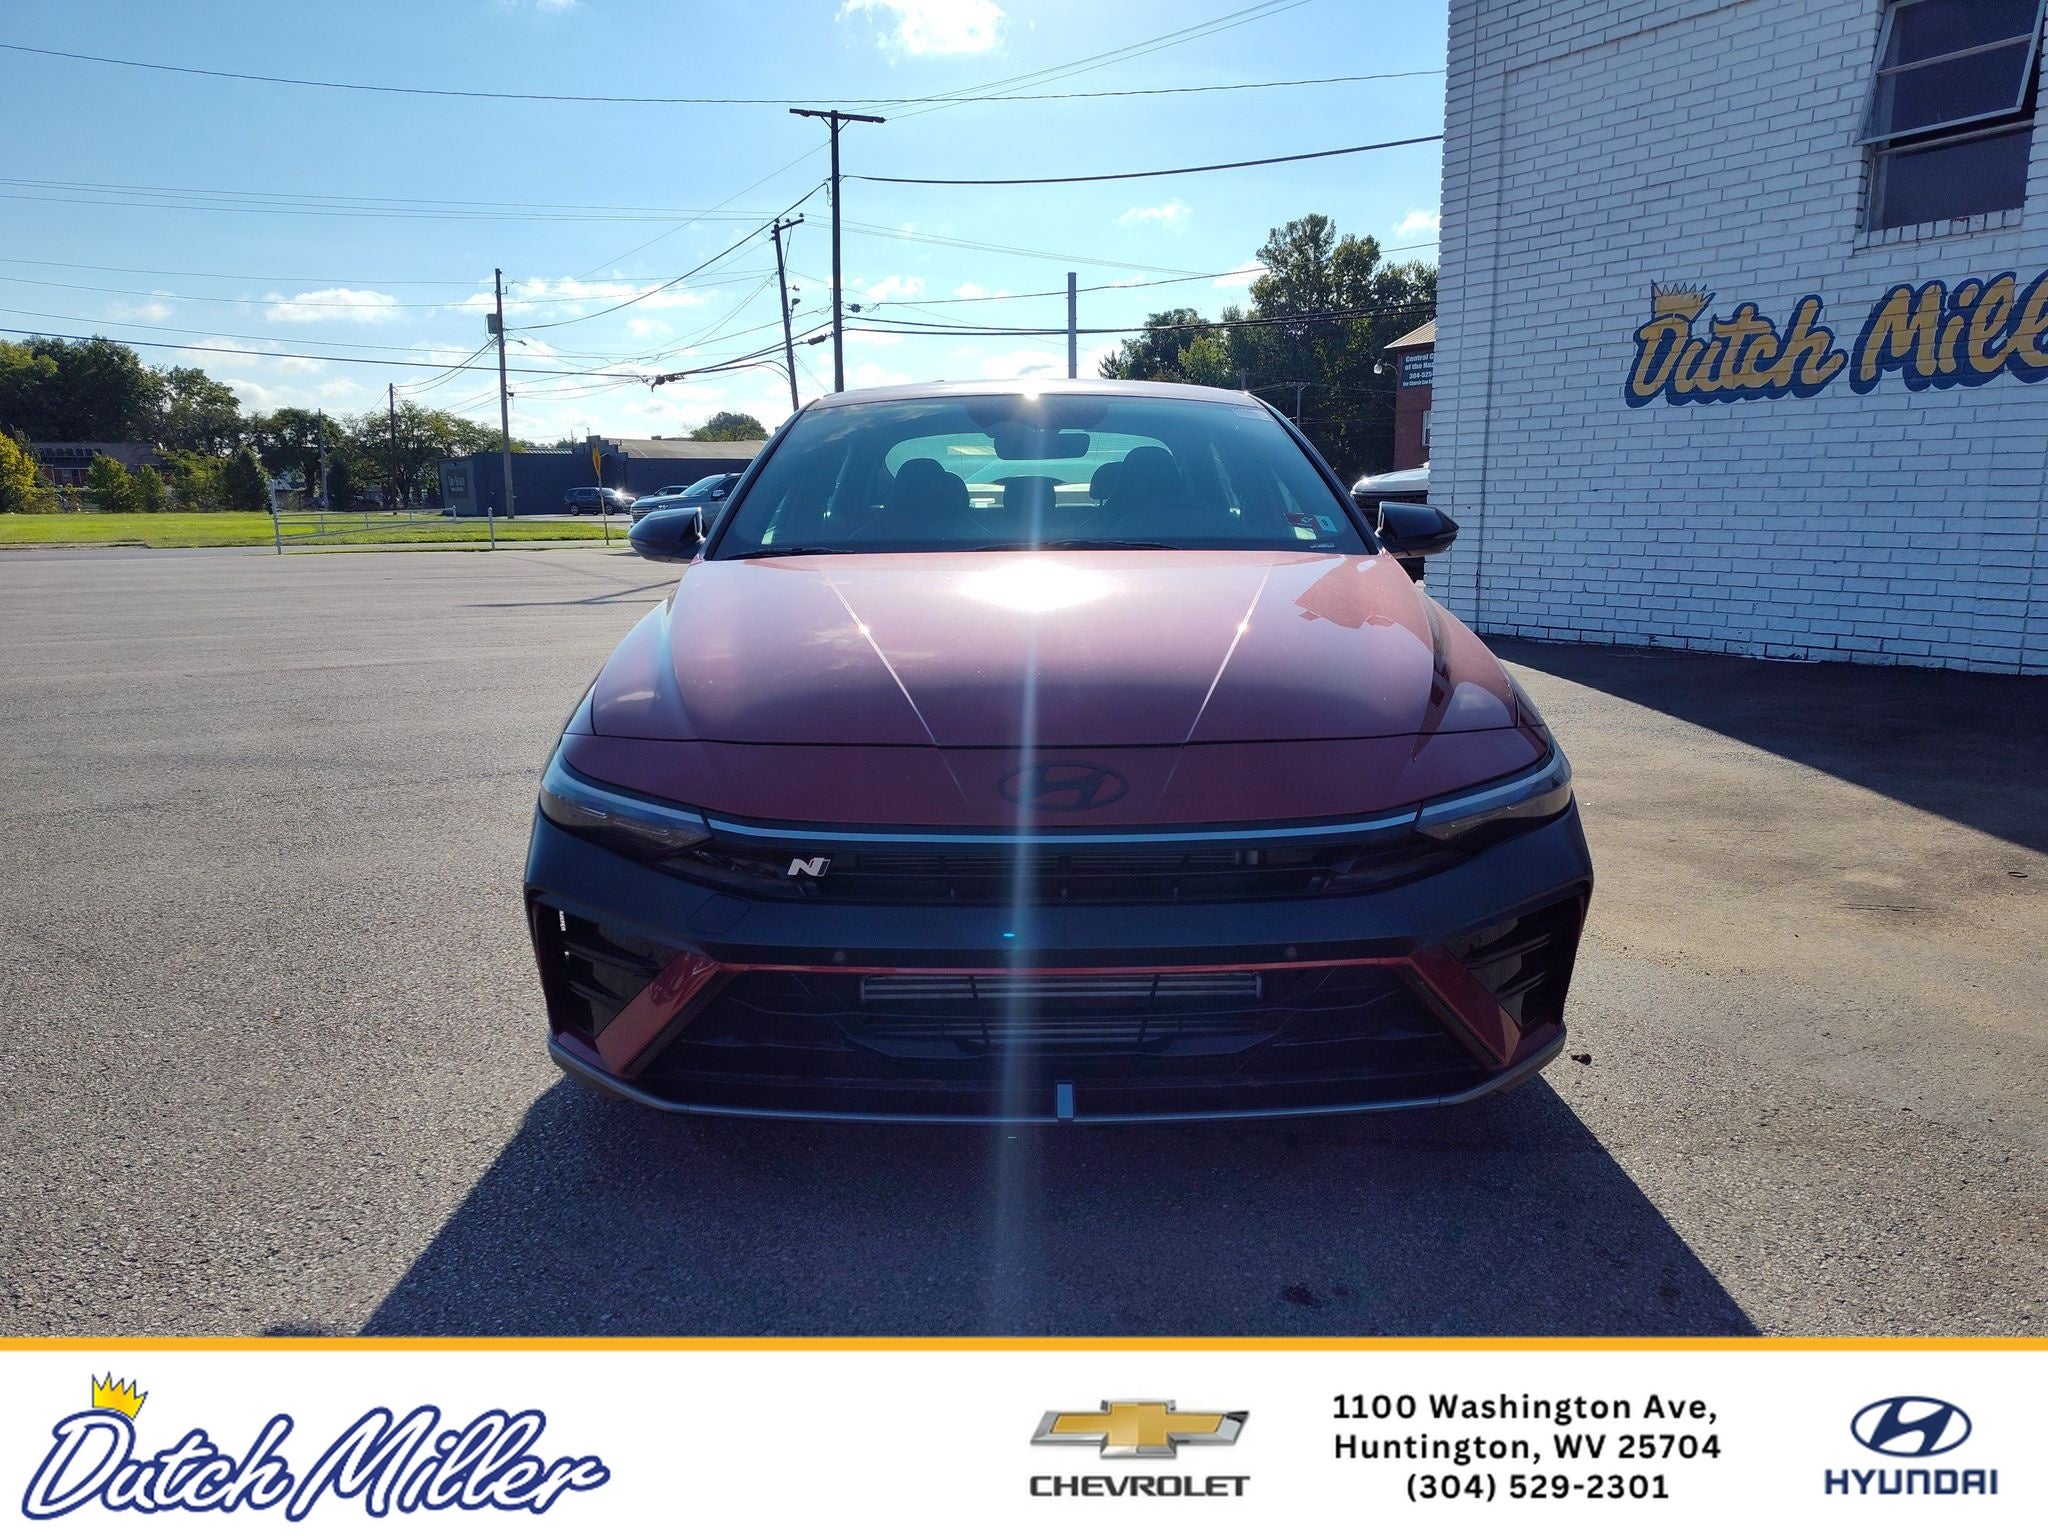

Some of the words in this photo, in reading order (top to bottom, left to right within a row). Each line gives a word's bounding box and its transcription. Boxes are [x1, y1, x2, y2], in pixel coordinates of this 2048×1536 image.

[1624, 294, 1849, 408] Dutch
[1405, 353, 1428, 362] Central
[1404, 363, 1411, 371] of
